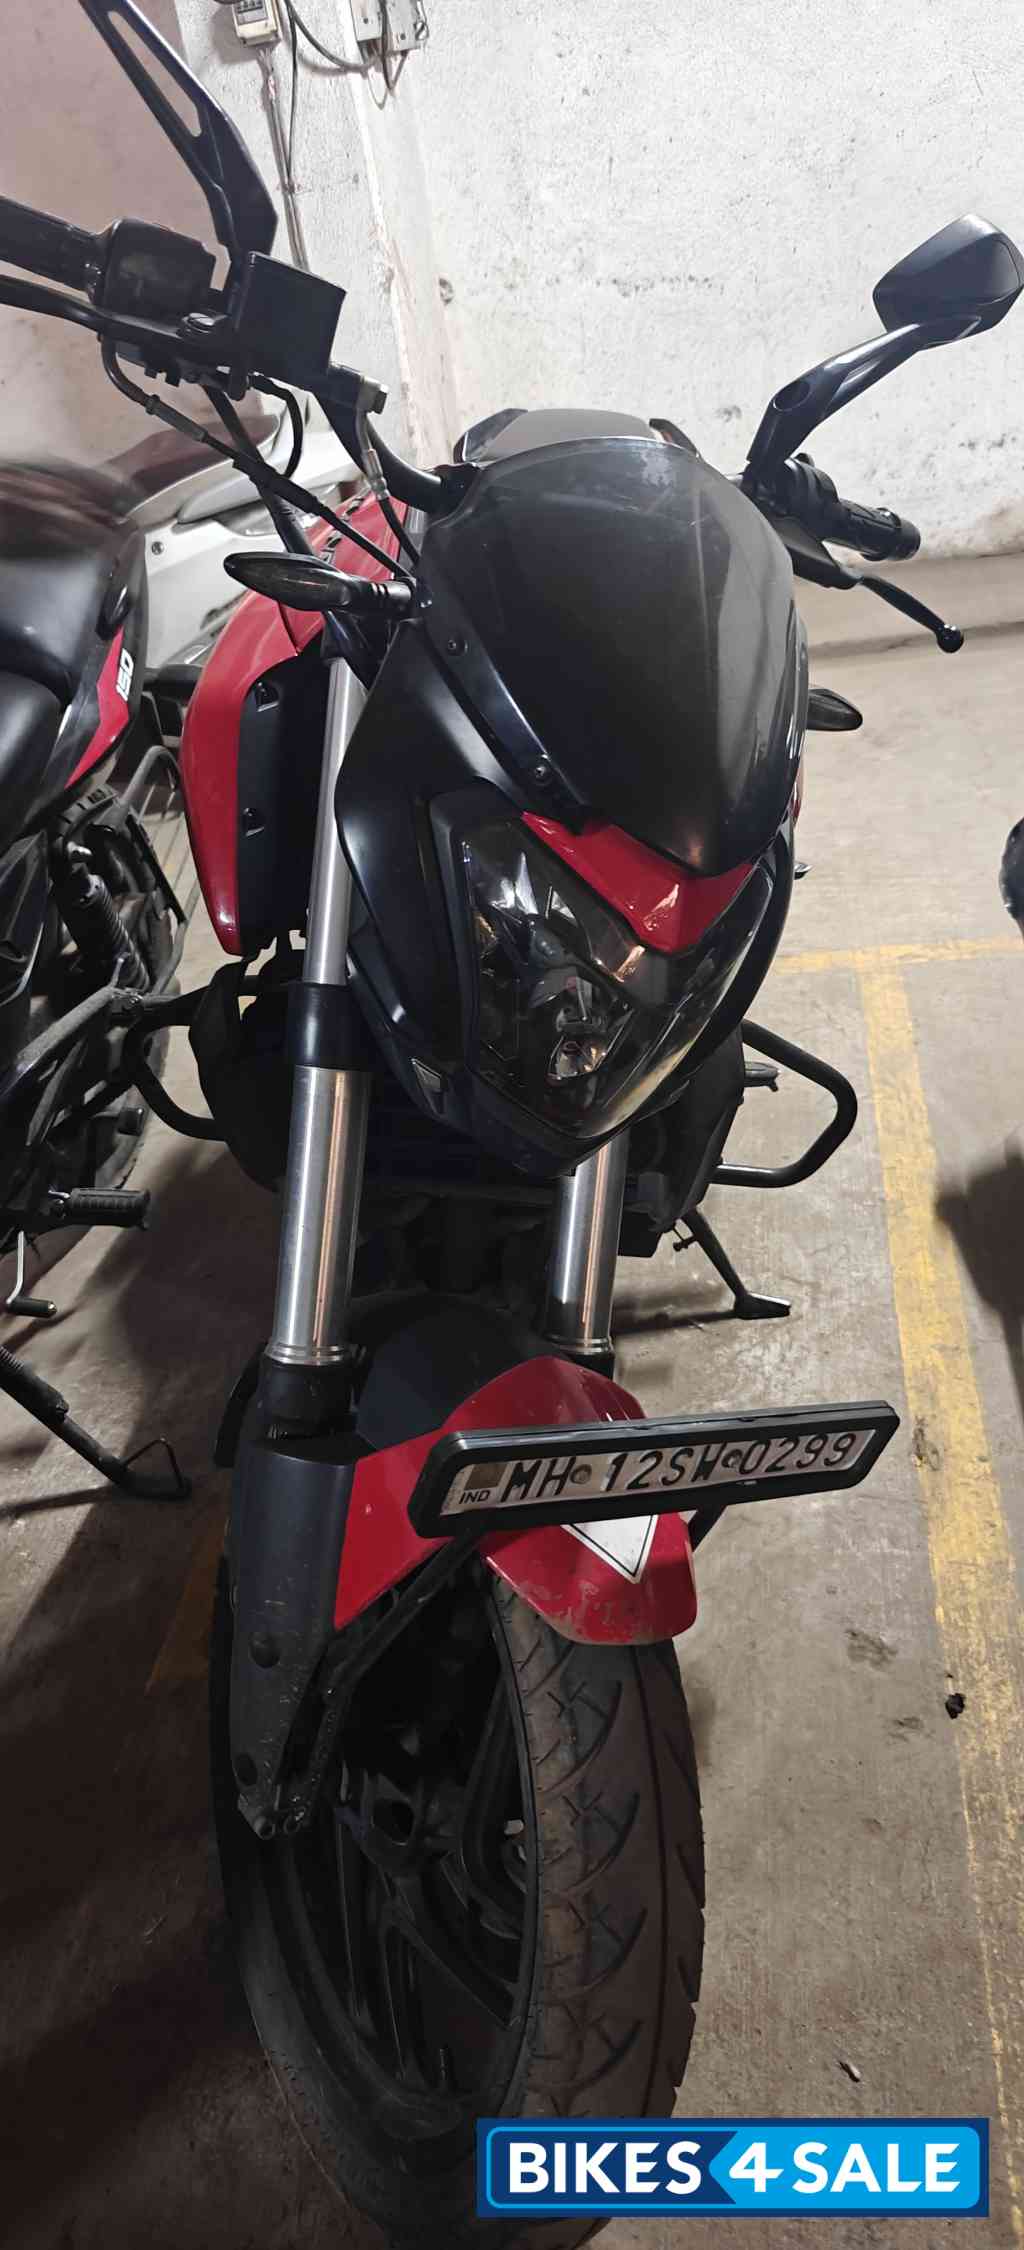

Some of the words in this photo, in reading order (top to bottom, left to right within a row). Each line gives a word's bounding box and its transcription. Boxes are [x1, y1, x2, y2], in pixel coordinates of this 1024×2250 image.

[117, 648, 134, 701] 150
[500, 1457, 577, 1503] MH
[739, 1433, 857, 1475] 0299
[459, 1490, 491, 1504] IND
